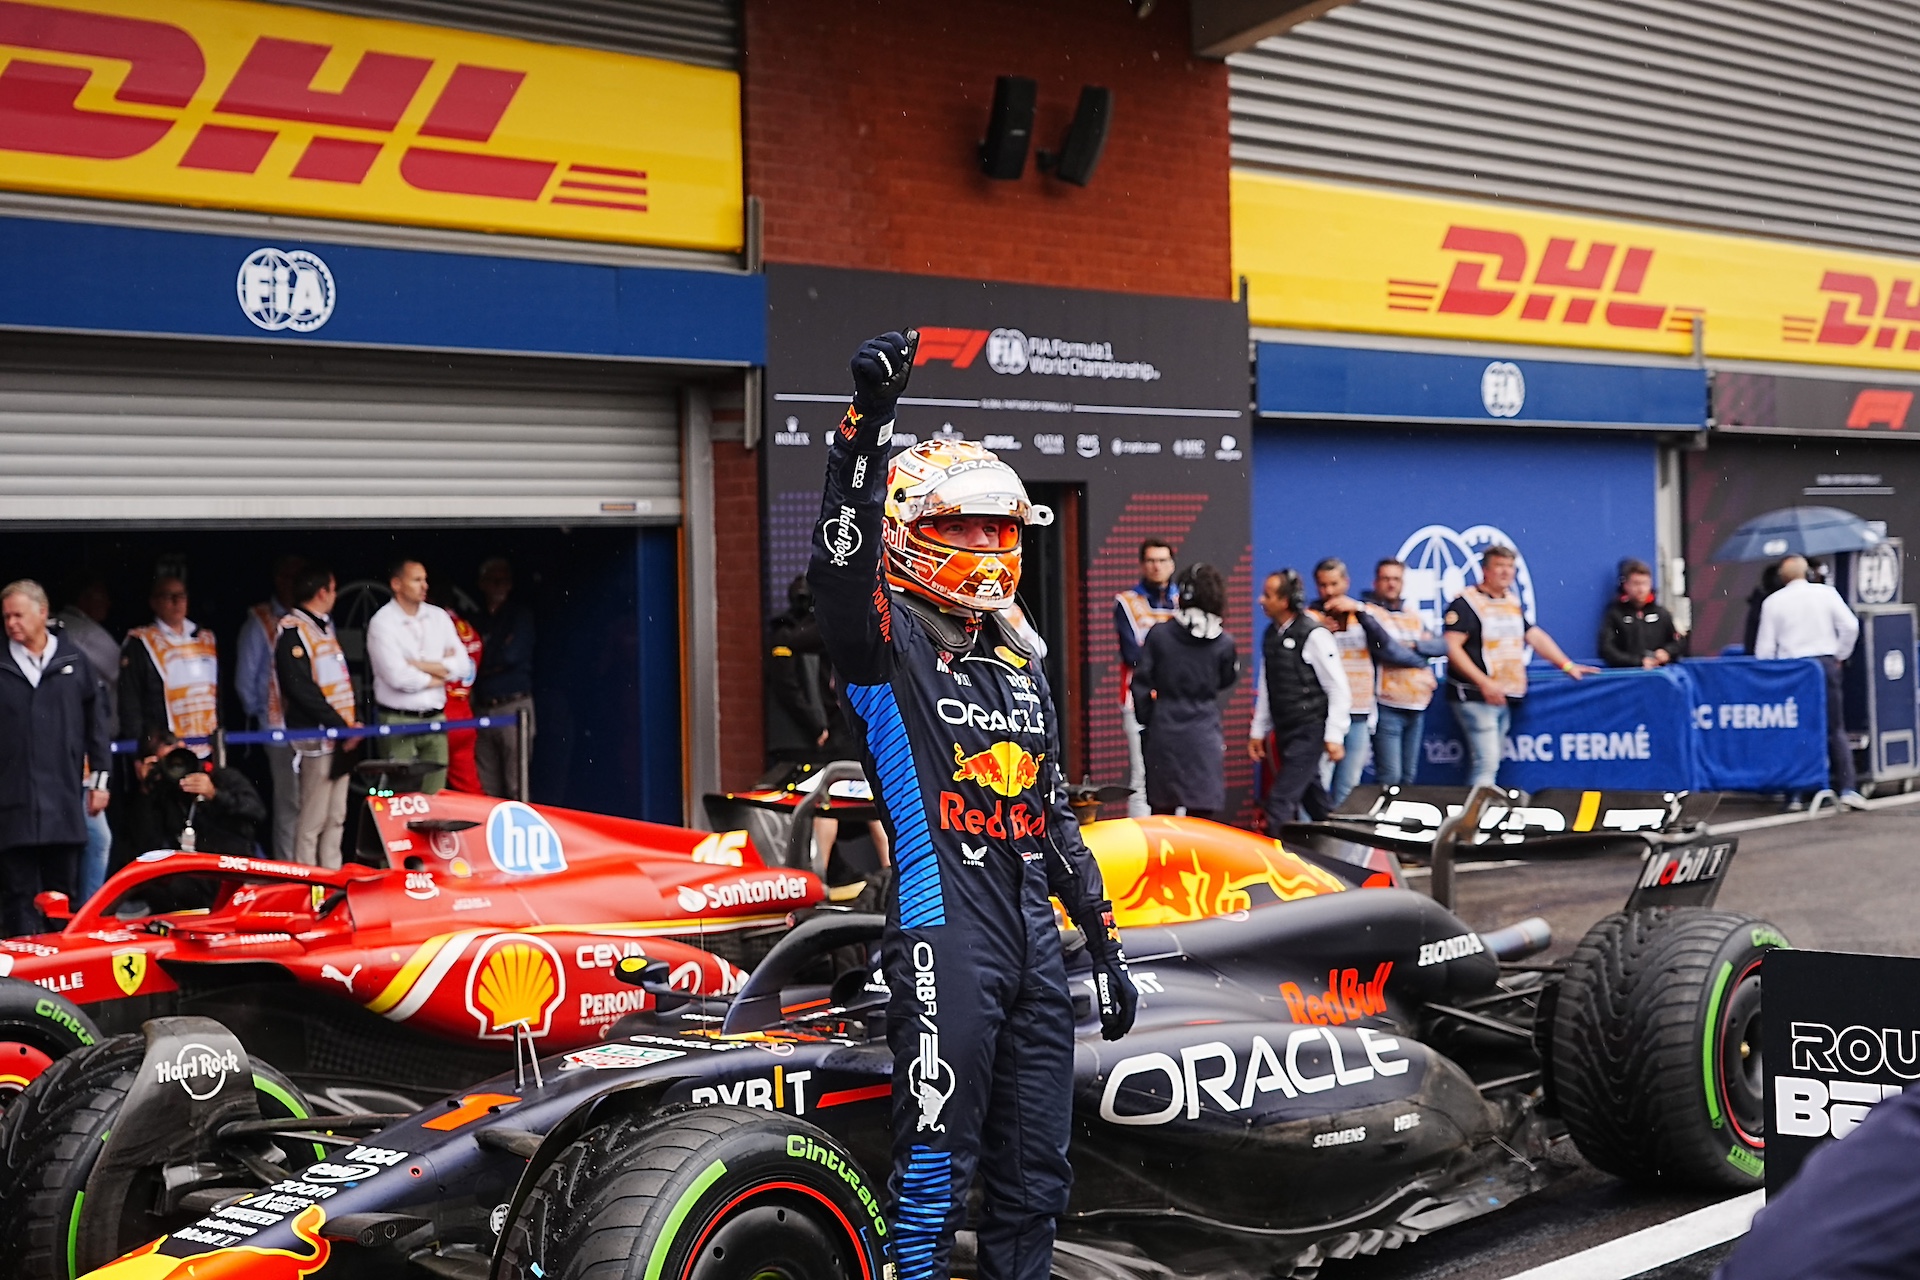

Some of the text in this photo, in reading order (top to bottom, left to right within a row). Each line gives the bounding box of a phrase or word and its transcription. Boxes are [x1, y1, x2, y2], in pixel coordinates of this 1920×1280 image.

[0, 0, 557, 201] DHL
[1437, 226, 1667, 330] DHL
[1029, 354, 1069, 375] World
[1718, 697, 1799, 729] FERMÉ
[1500, 724, 1651, 762] ARC FERMÉ
[940, 791, 1007, 840] Red
[503, 822, 551, 873] hp
[691, 829, 748, 867] 16
[250, 861, 311, 877] TECHNOLOGY
[1639, 846, 1704, 889] Mobil
[703, 874, 808, 909] Santander
[239, 933, 291, 945] HARMAN
[1417, 932, 1485, 967] HONDA
[580, 988, 646, 1018] PERONI
[1278, 961, 1394, 1026] Red Bull
[155, 1049, 240, 1084] Hard Rock
[1100, 1027, 1410, 1126] ORACLE
[1312, 1126, 1366, 1148] SIEMENS
[345, 1145, 409, 1167] VISA
[271, 1180, 338, 1199] zoom
[786, 1134, 888, 1237] Cinturato
[172, 1227, 226, 1244] Mobil
